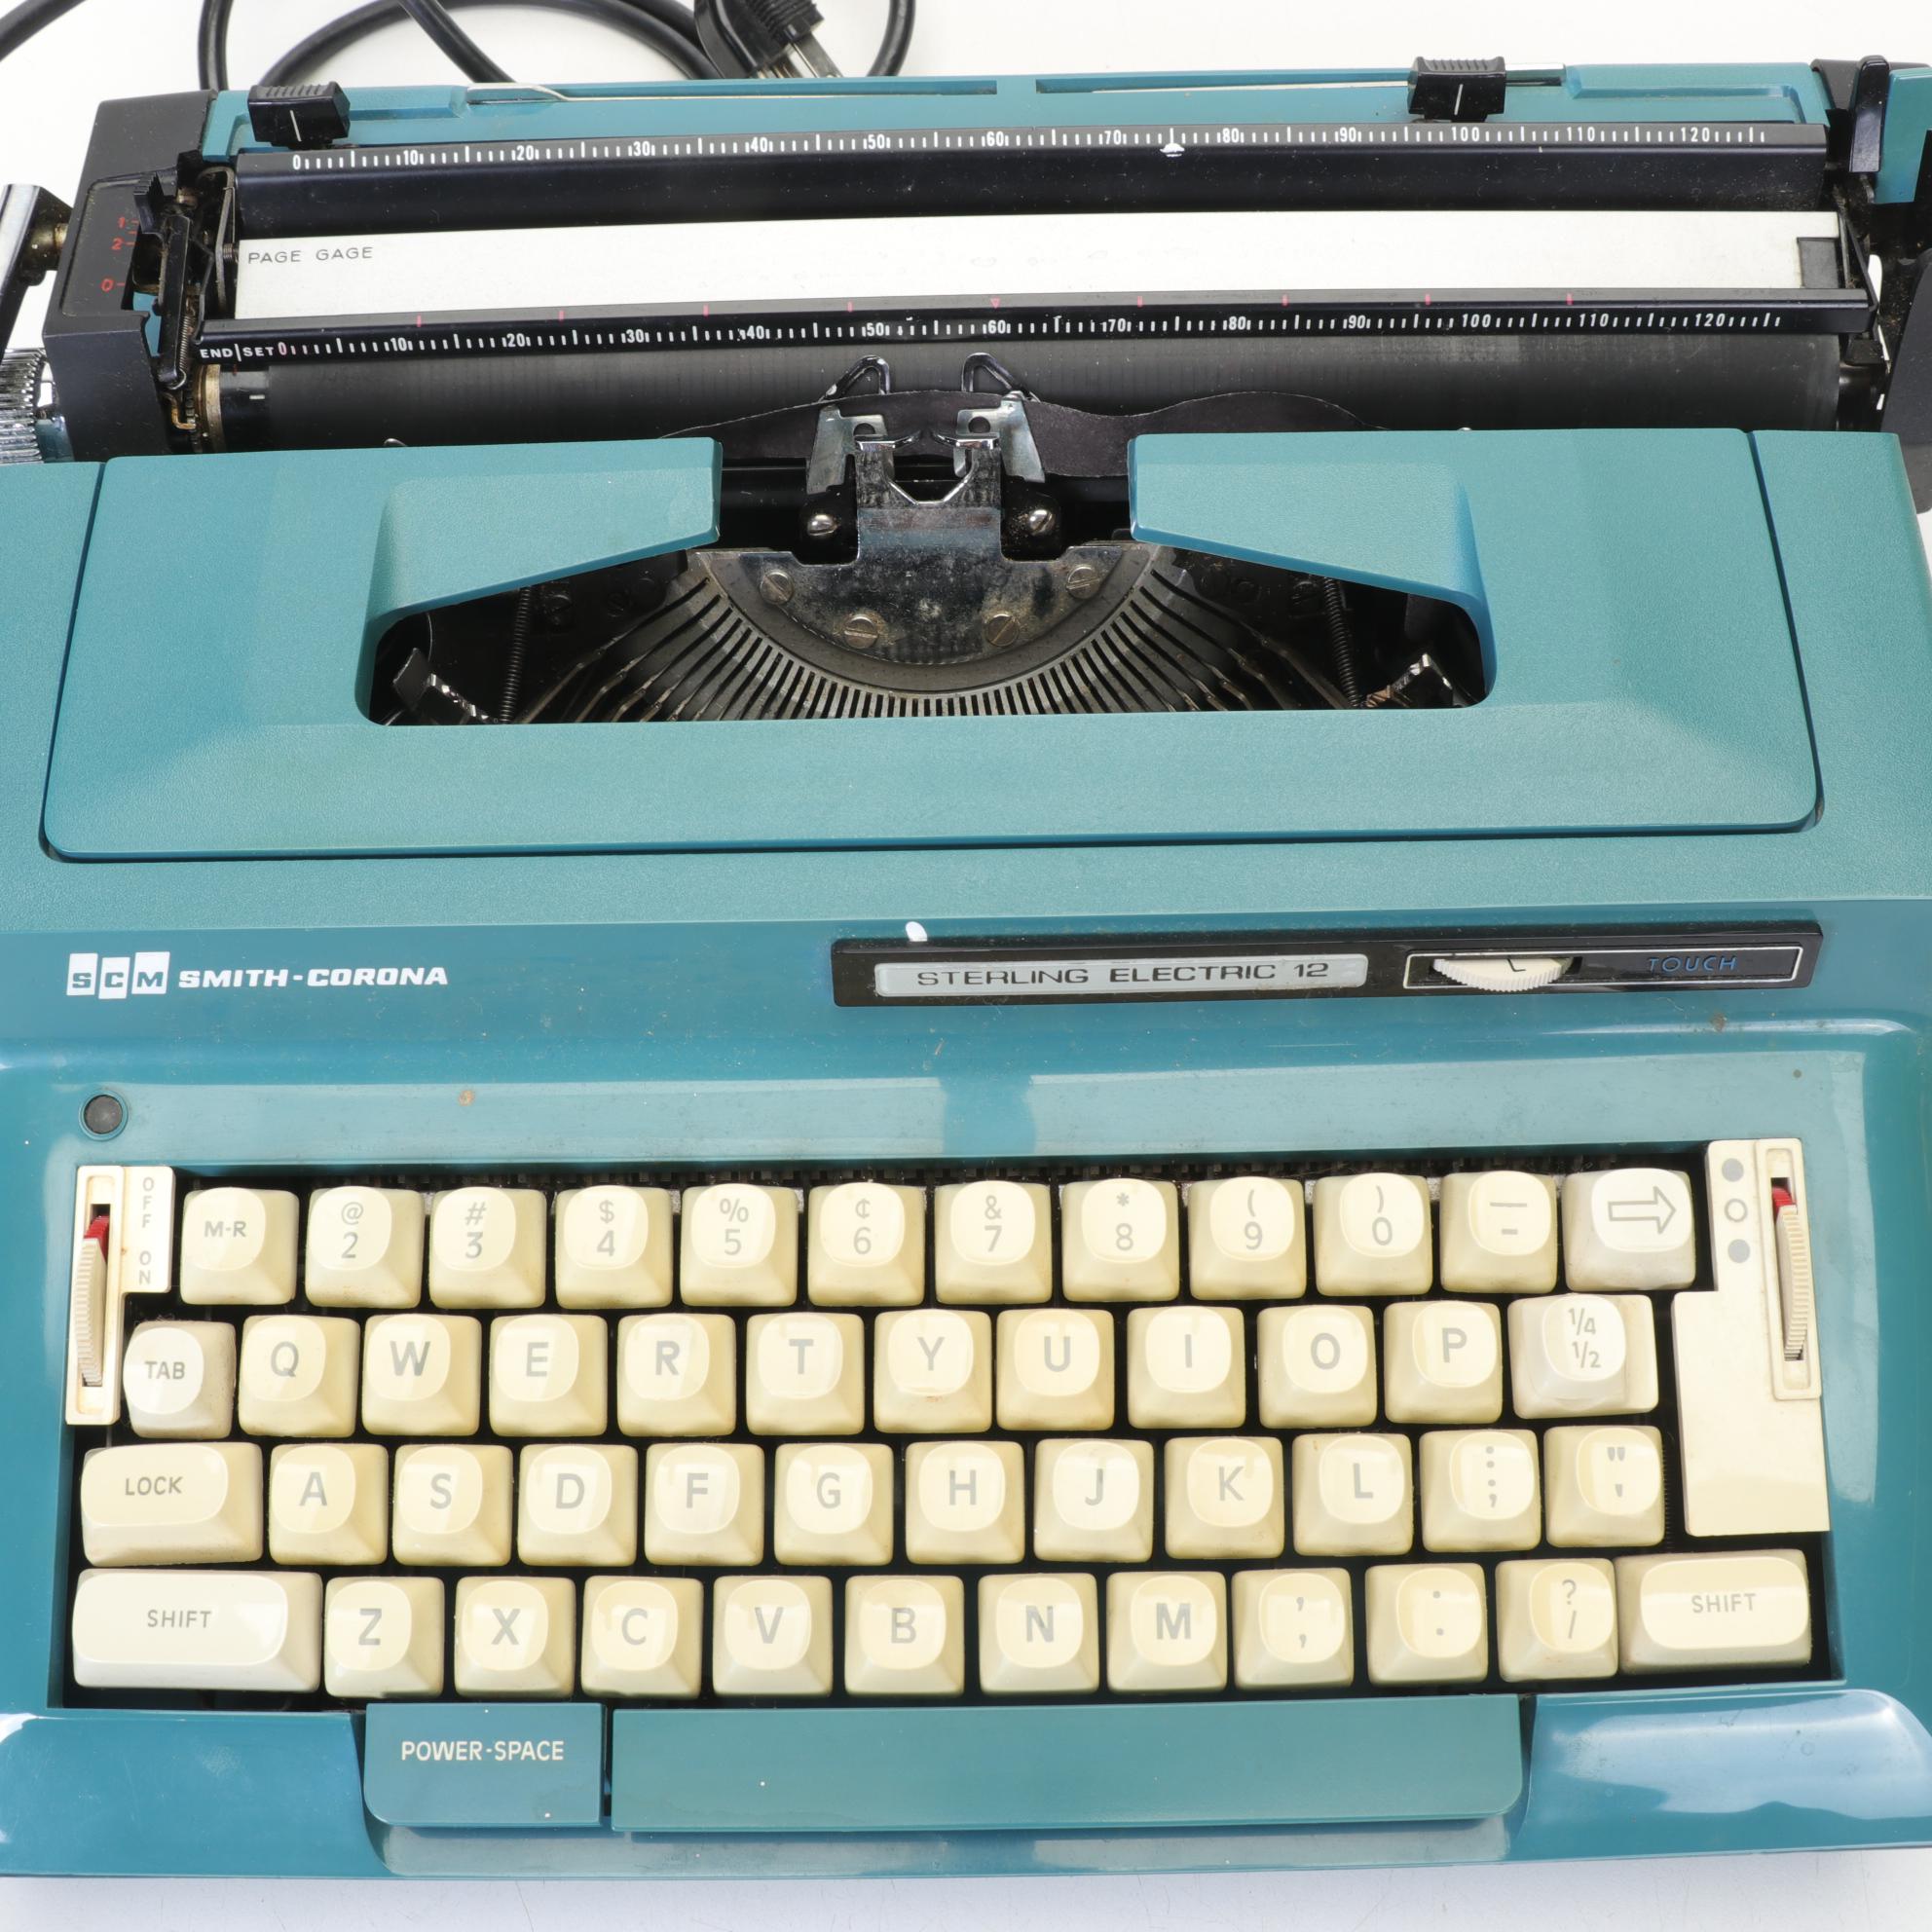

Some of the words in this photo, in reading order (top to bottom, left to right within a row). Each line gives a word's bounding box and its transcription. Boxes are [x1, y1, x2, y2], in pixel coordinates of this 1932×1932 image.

[293, 154, 301, 169] 0
[403, 150, 419, 167] 10
[516, 145, 534, 163] 20
[632, 141, 650, 158] 30
[750, 136, 768, 153] 40
[868, 133, 885, 150] 50
[985, 130, 1005, 147] 60
[1103, 130, 1121, 146] 70
[1222, 128, 1240, 144] 80
[1339, 127, 1356, 144] 90
[1451, 127, 1480, 143] 100
[1567, 126, 1595, 143] 110
[1681, 125, 1709, 142] 120
[118, 217, 126, 228] 1
[112, 238, 123, 250] 2
[247, 249, 302, 265] PAGE
[316, 245, 373, 262] GAGE
[101, 279, 115, 292] 0
[279, 341, 287, 357] 0
[390, 337, 406, 353] 10
[506, 333, 525, 350] 20
[626, 328, 645, 345] 30
[746, 324, 765, 341] 40
[866, 321, 884, 338] 50
[987, 319, 1006, 335] 60
[1108, 317, 1127, 334] 70
[1228, 316, 1246, 333] 80
[1348, 314, 1365, 330] 90
[1462, 313, 1492, 330] 100
[1579, 312, 1609, 328] 110
[1694, 311, 1726, 328] 120
[178, 967, 448, 988] SMITH-CORONA
[917, 968, 1089, 985] STERLING
[1109, 964, 1277, 983] ELECTRIC
[1293, 962, 1328, 978] 12
[1650, 954, 1738, 973] TOUCH
[341, 1202, 364, 1225] @
[465, 1202, 487, 1225] #
[598, 1200, 614, 1223] $
[720, 1199, 749, 1223] %
[985, 1195, 1002, 1220] &
[204, 1220, 247, 1238] M-R
[597, 1230, 615, 1256] 4
[724, 1229, 742, 1255] 5
[853, 1227, 872, 1255] 6
[985, 1226, 1002, 1251] 7
[1115, 1223, 1133, 1250] 8
[1245, 1222, 1263, 1250] 9
[342, 1233, 358, 1258] 2
[465, 1232, 483, 1258] 3
[390, 1341, 430, 1376] W
[655, 1340, 681, 1376] R
[790, 1339, 814, 1374] T
[917, 1336, 946, 1371] Y
[1044, 1335, 1071, 1372] U
[1441, 1327, 1468, 1362] P
[145, 1361, 185, 1380] TAB
[271, 1341, 299, 1377] Q
[526, 1342, 549, 1377] E
[125, 1476, 183, 1496] LOCK
[299, 1471, 328, 1506] A
[429, 1473, 453, 1509] S
[555, 1473, 584, 1509] D
[686, 1472, 709, 1508] F
[816, 1472, 841, 1508] G
[948, 1469, 978, 1505] H
[1085, 1468, 1104, 1505] J
[1218, 1466, 1245, 1502] K
[1353, 1463, 1374, 1499] L
[1562, 1579, 1577, 1606] ?
[1691, 1593, 1757, 1614] SHIFT
[146, 1610, 211, 1628] SHIFT
[357, 1608, 383, 1646] Z
[492, 1609, 521, 1645] X
[621, 1608, 649, 1645] C
[755, 1607, 784, 1644] V
[890, 1608, 916, 1644] B
[1025, 1605, 1055, 1643] N
[1156, 1603, 1191, 1640] M
[401, 1741, 564, 1762] POWER-SPACE
